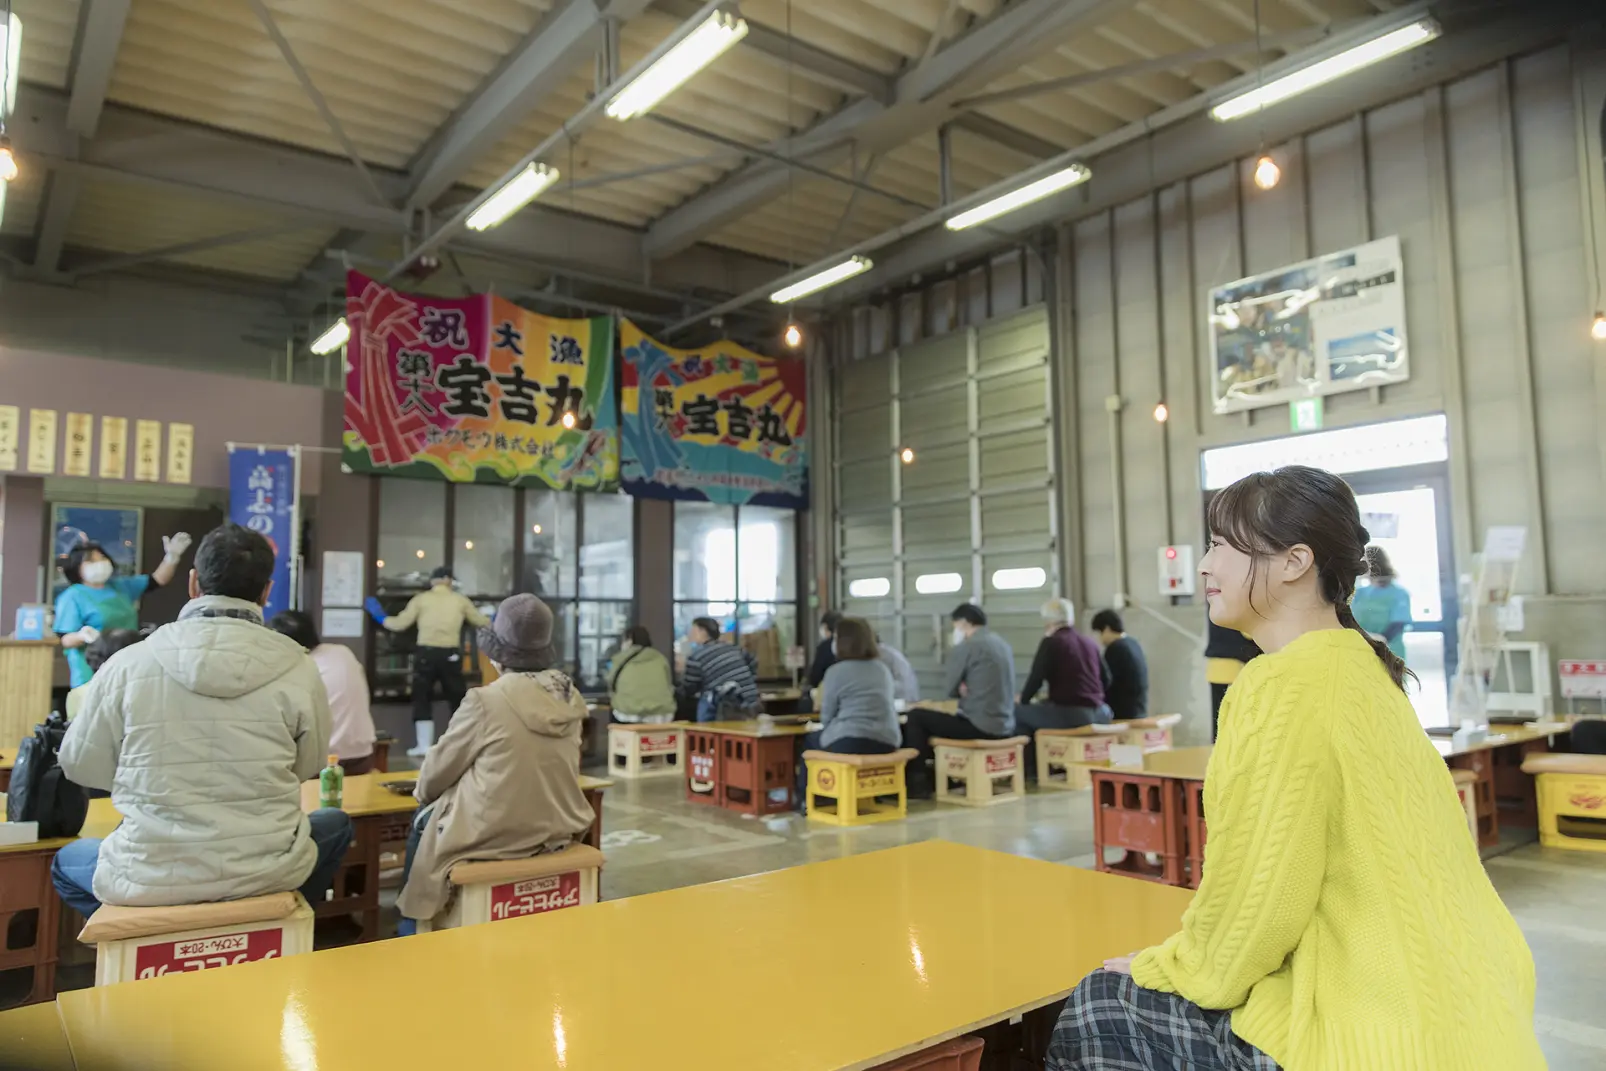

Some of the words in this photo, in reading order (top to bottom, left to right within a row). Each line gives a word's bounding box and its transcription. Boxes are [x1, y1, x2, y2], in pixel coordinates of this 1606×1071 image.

[434, 354, 593, 431] 宝吉丸
[681, 393, 793, 446] 宝吉丸
[492, 887, 579, 919] アサヒビール
[179, 937, 245, 956] 大びん・20本
